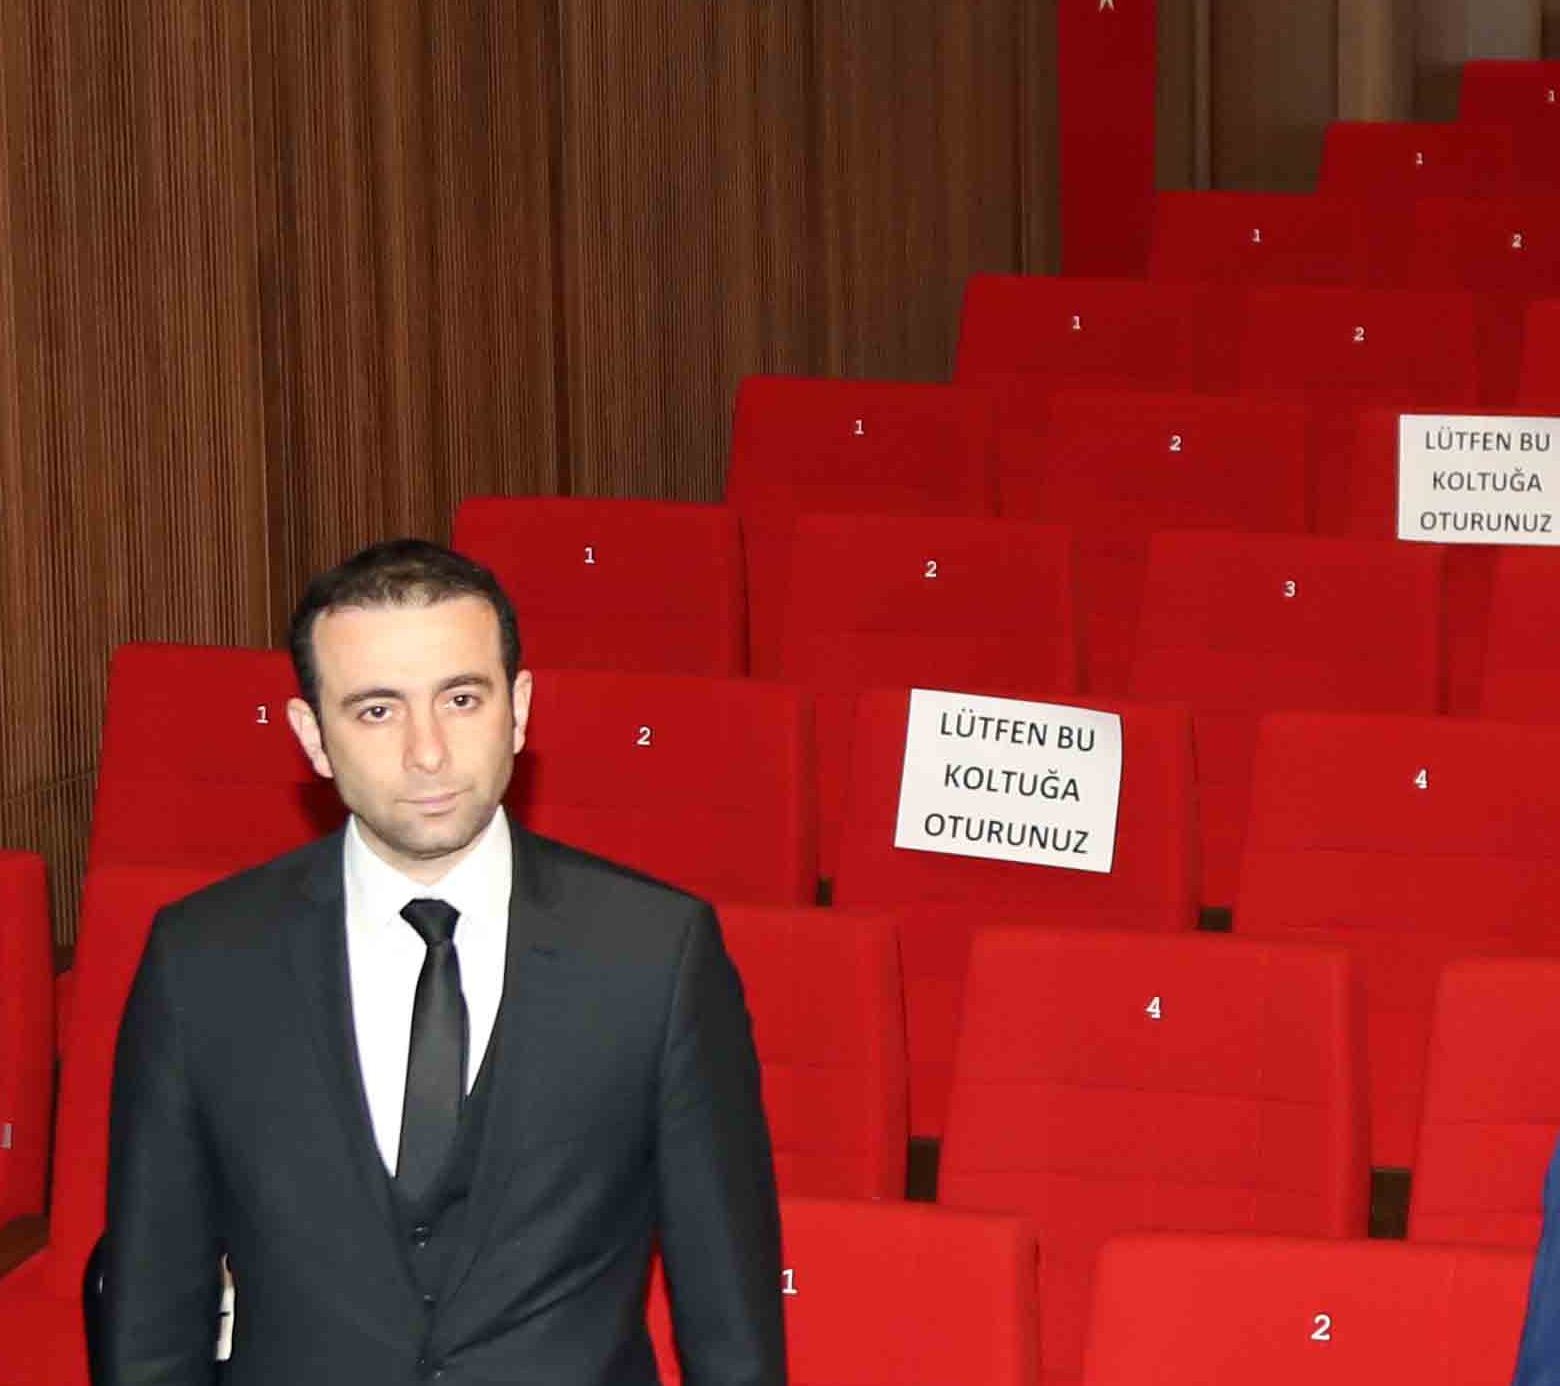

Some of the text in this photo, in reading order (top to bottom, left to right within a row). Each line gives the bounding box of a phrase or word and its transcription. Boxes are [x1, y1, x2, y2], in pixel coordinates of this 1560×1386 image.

[1253, 228, 1261, 243] 1
[1511, 234, 1522, 248] 2
[1072, 315, 1081, 330] 1
[1353, 326, 1365, 342] 2
[854, 419, 864, 435] 1
[1169, 435, 1182, 452] 2
[1425, 425, 1551, 453] LÜTFEN BU
[1432, 468, 1542, 494] KOLTUĞA
[1419, 511, 1553, 534] OTURUNUZ
[584, 547, 595, 564] 1
[924, 560, 937, 578] 2
[1284, 580, 1296, 598] 3
[256, 705, 269, 724] 1
[636, 726, 651, 746] 2
[940, 708, 1096, 752] LÜTFEN BU
[943, 764, 1081, 802] KOLTUĞA
[1414, 769, 1428, 789] 4
[924, 812, 1089, 855] OTURUNUZ
[1145, 996, 1161, 1019] 4
[782, 1268, 798, 1295] 1
[1311, 1314, 1331, 1341] 2
